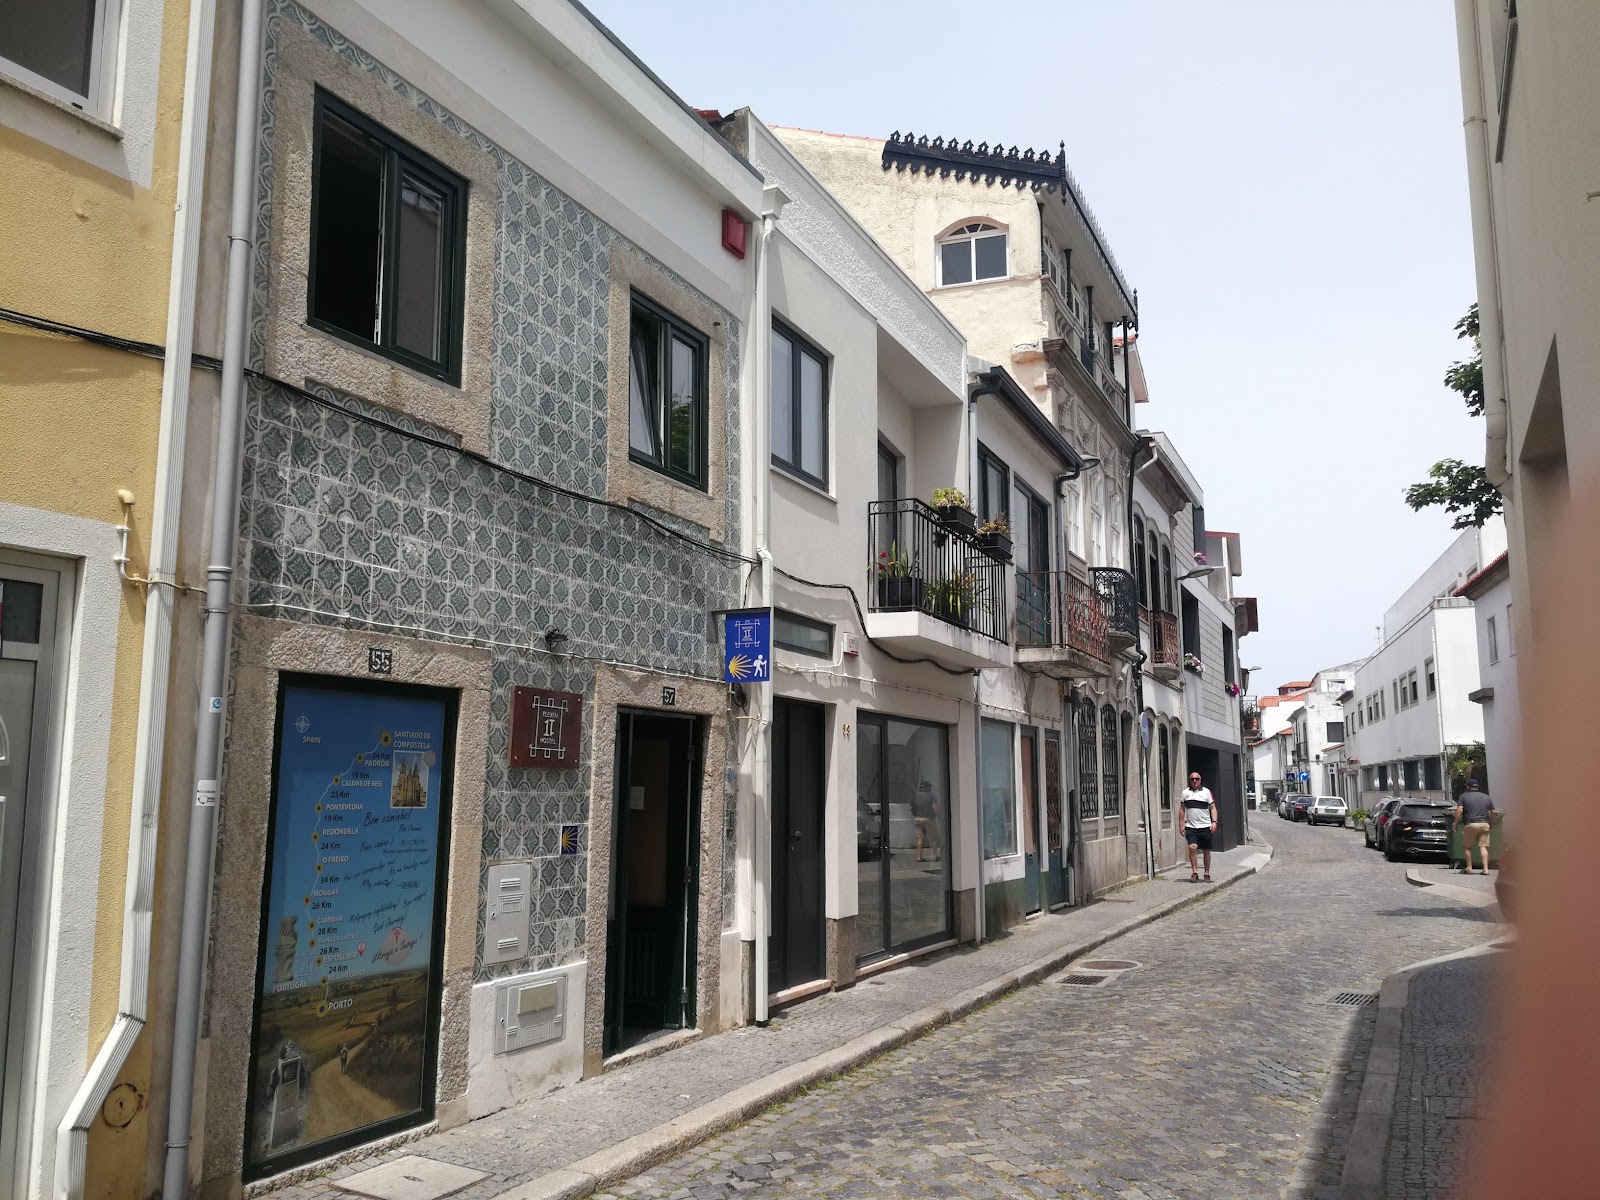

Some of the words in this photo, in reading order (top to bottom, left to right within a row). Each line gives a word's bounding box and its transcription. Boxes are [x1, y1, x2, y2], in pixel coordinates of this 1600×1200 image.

[372, 650, 390, 671] 55
[664, 688, 674, 703] 57
[302, 736, 321, 744] SPAIN
[423, 732, 431, 740] DE
[393, 741, 431, 749] COMPOSTELA
[364, 758, 390, 767] PADRÓN
[326, 803, 363, 811] PONTEVEDRA
[322, 828, 359, 836] REDONDELA
[312, 902, 320, 910] 26
[317, 915, 342, 924] CAMINHA
[329, 946, 339, 954] Km
[323, 952, 358, 963] ESPOSENDE
[329, 966, 337, 974] 24
[272, 980, 308, 992] PORTUGAL
[329, 999, 353, 1010] PORTO
